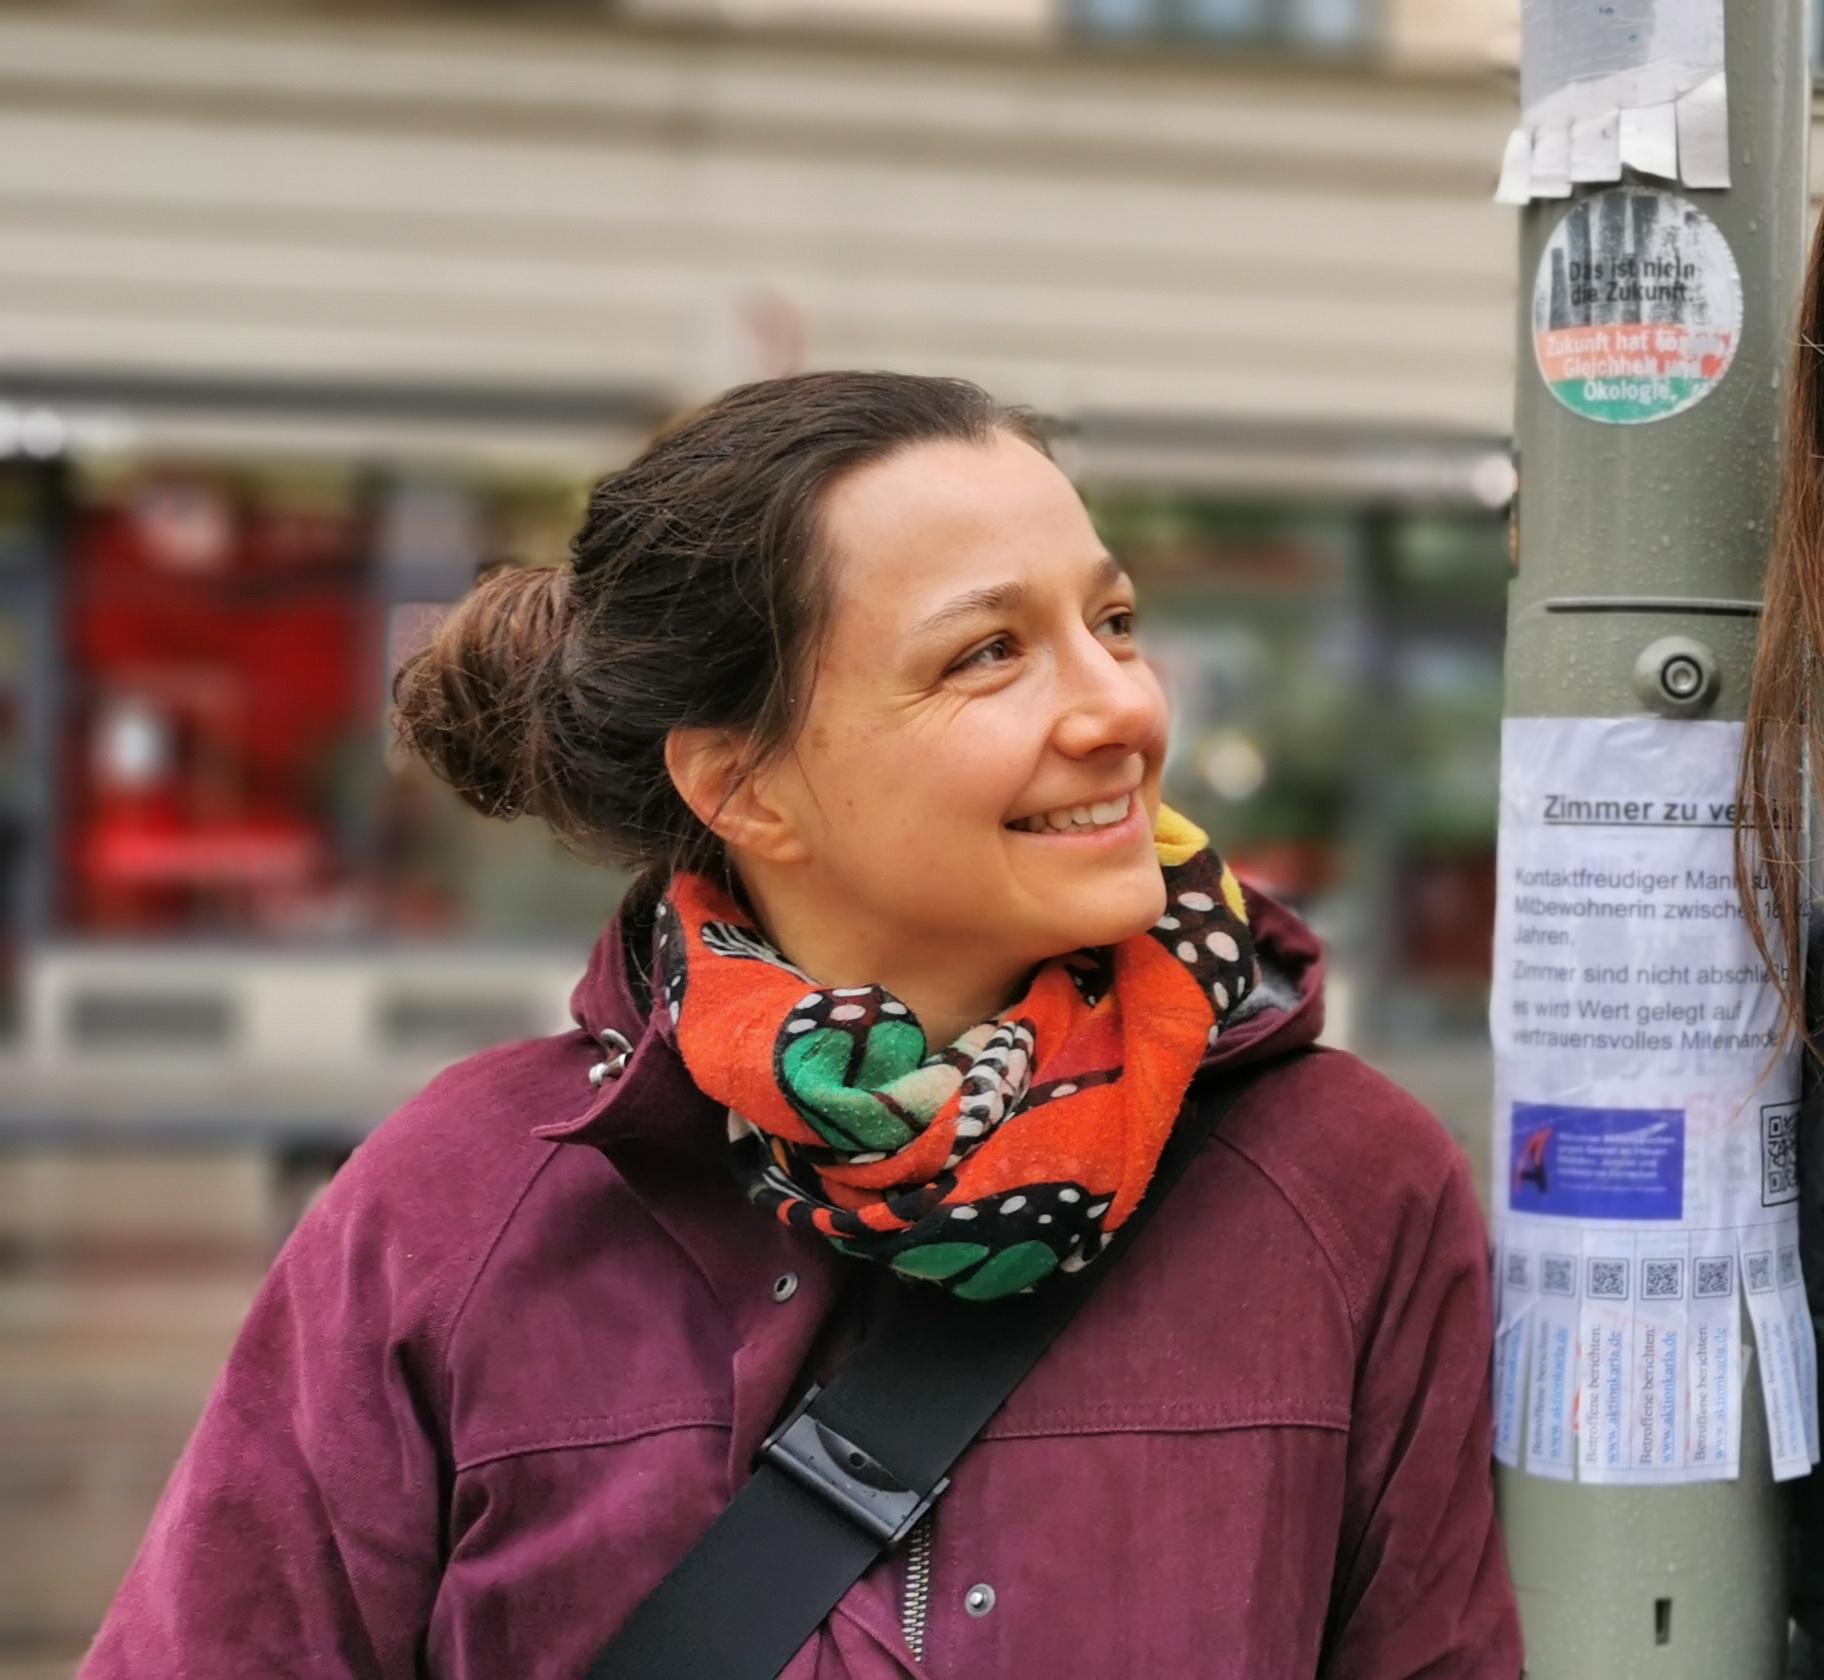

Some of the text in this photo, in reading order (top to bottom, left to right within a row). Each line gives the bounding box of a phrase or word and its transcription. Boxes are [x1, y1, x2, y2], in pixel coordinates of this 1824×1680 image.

[1569, 261, 1603, 282] Das
[1611, 257, 1638, 279] ist
[1571, 280, 1694, 306] die Zukunft.
[1615, 328, 1648, 353] hat
[1543, 795, 1654, 821] Zimmer
[1663, 803, 1698, 822] zu
[1514, 867, 1678, 894] Kontaktfreudiger
[1514, 896, 1657, 920] Mitbewohnerin
[1513, 924, 1575, 946] Jahren.
[1512, 959, 1577, 982] Zimmer
[1583, 963, 1629, 984] sind
[1636, 965, 1690, 986] nicht
[1534, 1000, 1570, 1018] wird
[1578, 999, 1630, 1020] Wert
[1637, 1001, 1705, 1026] gelegt
[1712, 1001, 1743, 1021] auf
[1511, 1027, 1673, 1050] vertrauensvolles
[1586, 1393, 1599, 1462] Betroffene
[1640, 1394, 1654, 1464] Betroffene
[1694, 1392, 1708, 1461] Betroffene
